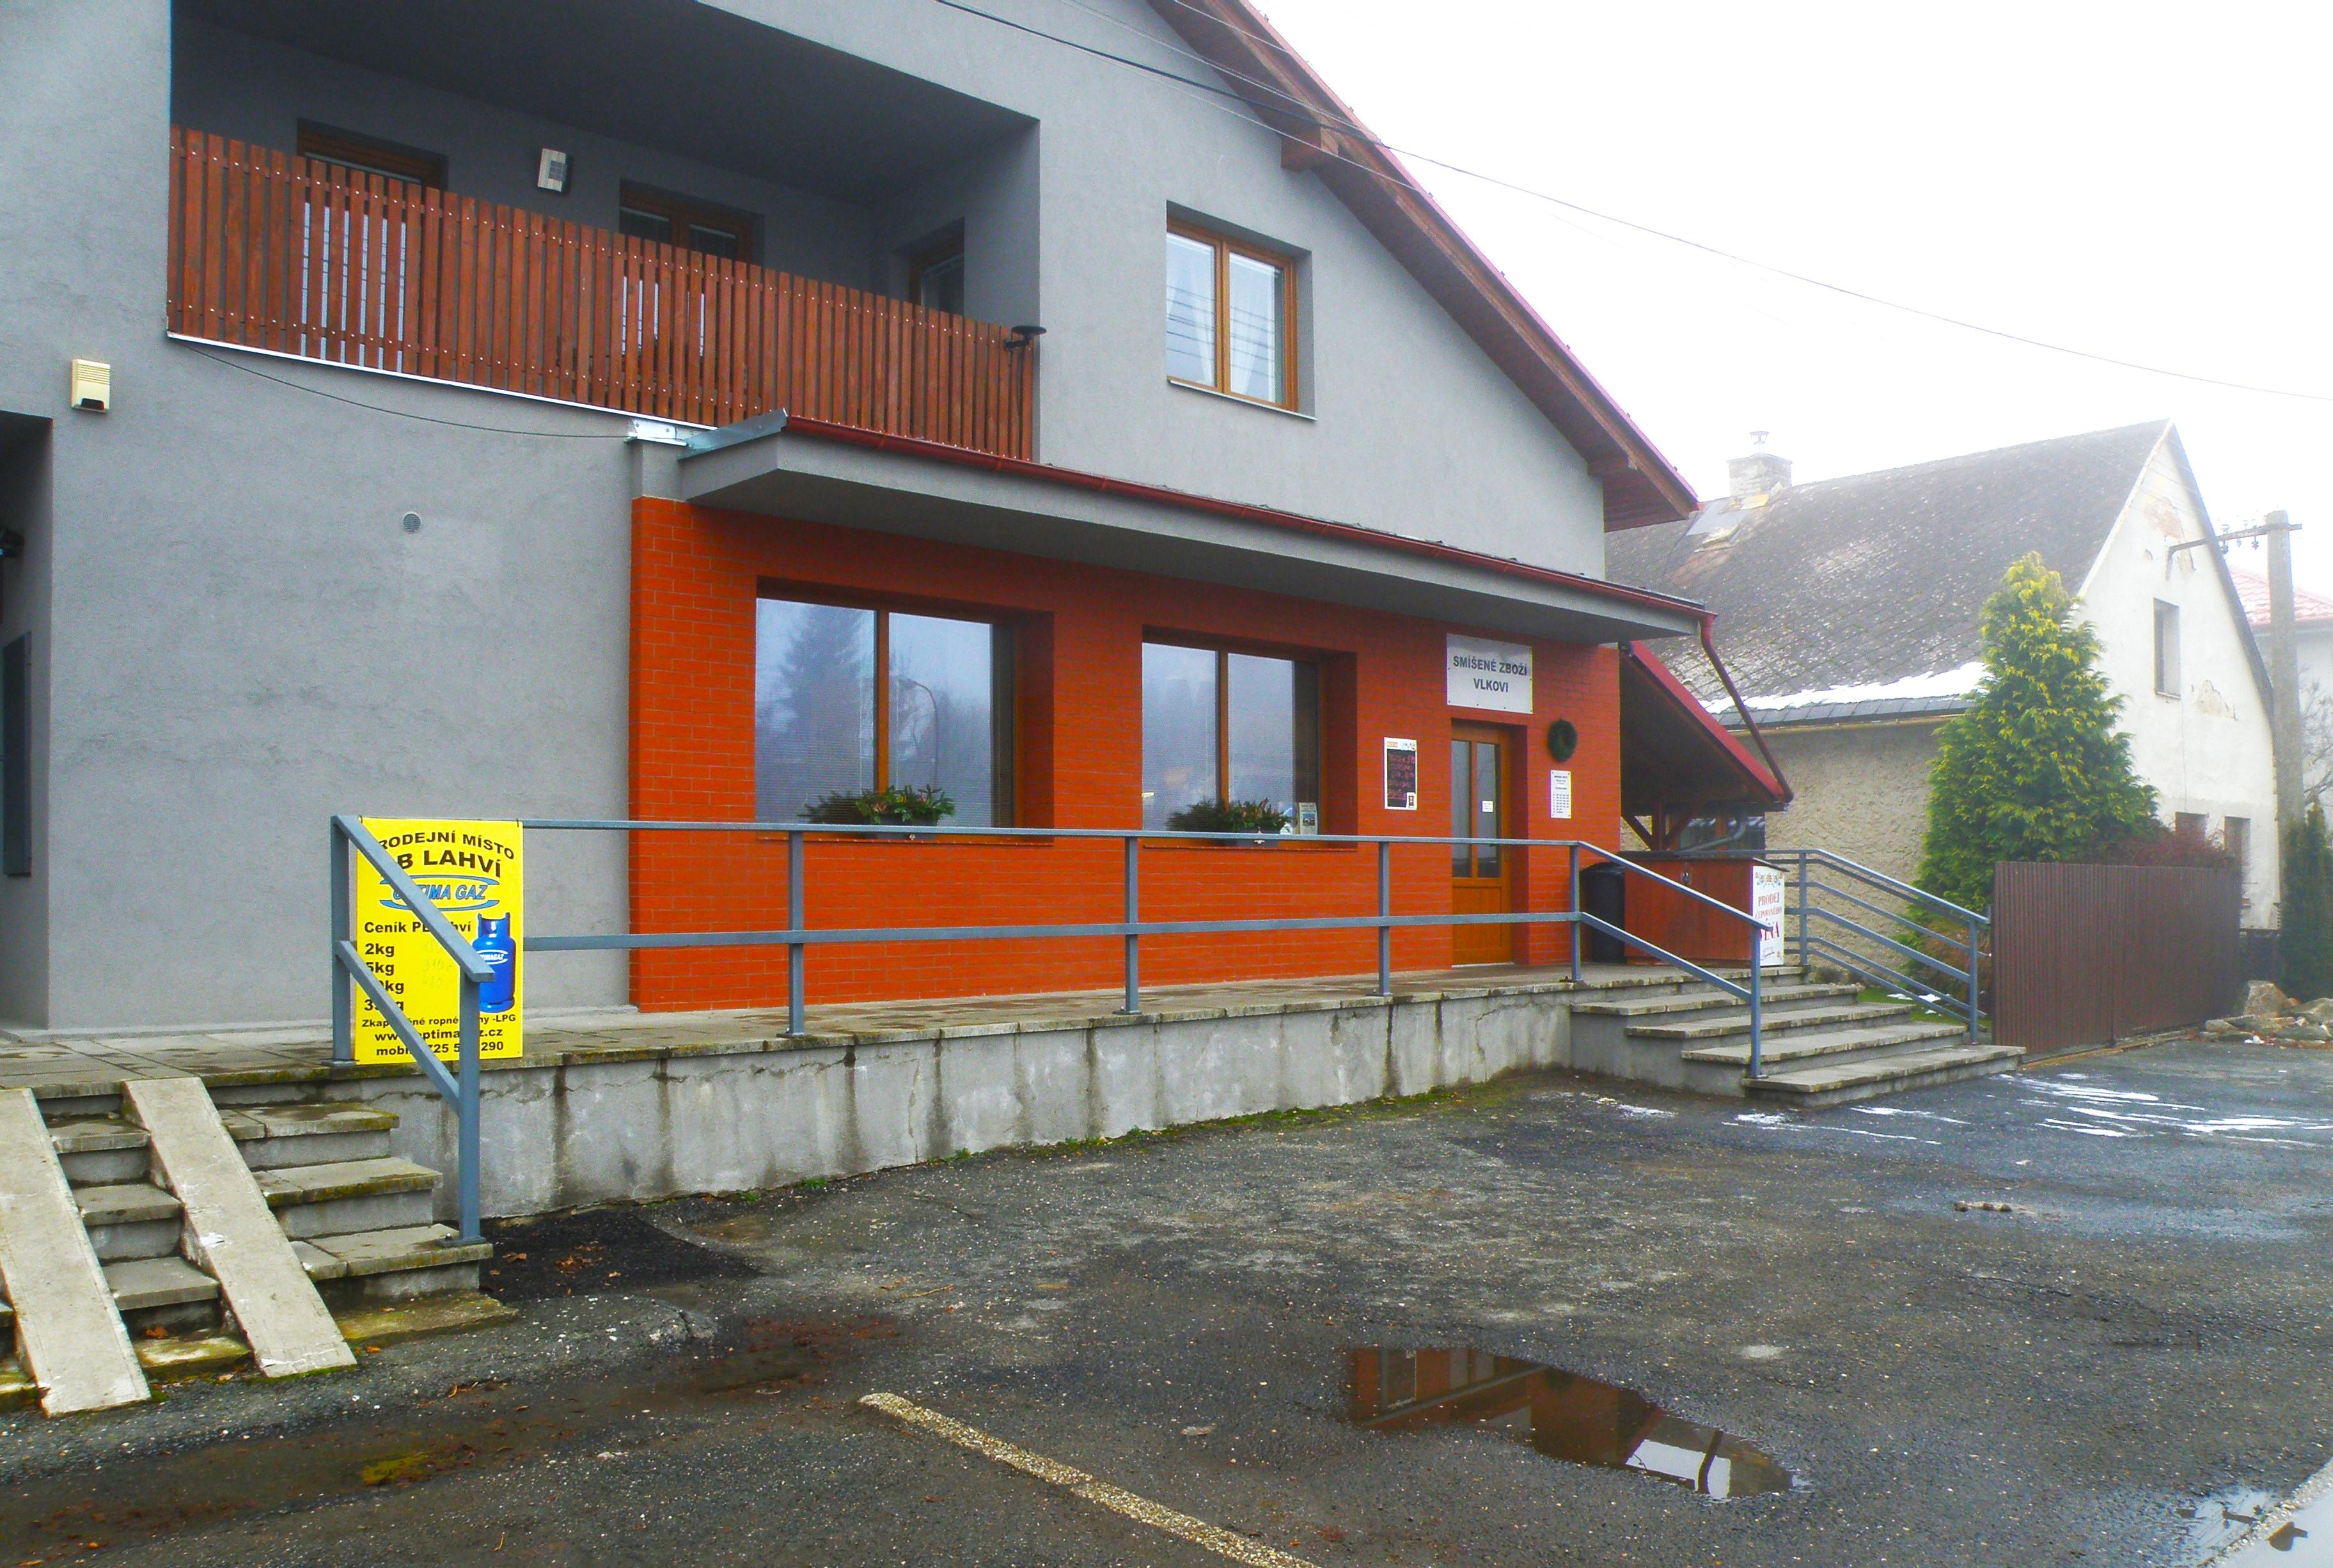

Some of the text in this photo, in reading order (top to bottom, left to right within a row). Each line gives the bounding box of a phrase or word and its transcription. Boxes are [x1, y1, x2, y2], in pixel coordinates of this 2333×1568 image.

[1453, 655, 1527, 676] SMÍŠENÉ ZBOŽÍ
[1473, 678, 1508, 693] VLKOVI
[379, 830, 514, 859] RODEJNÍ MÍSTO
[397, 850, 501, 878] B LAHVÍ
[455, 884, 488, 900] GAZ
[1758, 892, 1780, 906] PRODEJ
[364, 921, 407, 933] Ceník
[365, 943, 395, 958] 2kg
[366, 962, 395, 976] 5kg
[428, 1016, 459, 1026] ropné
[481, 1041, 504, 1051] 290
